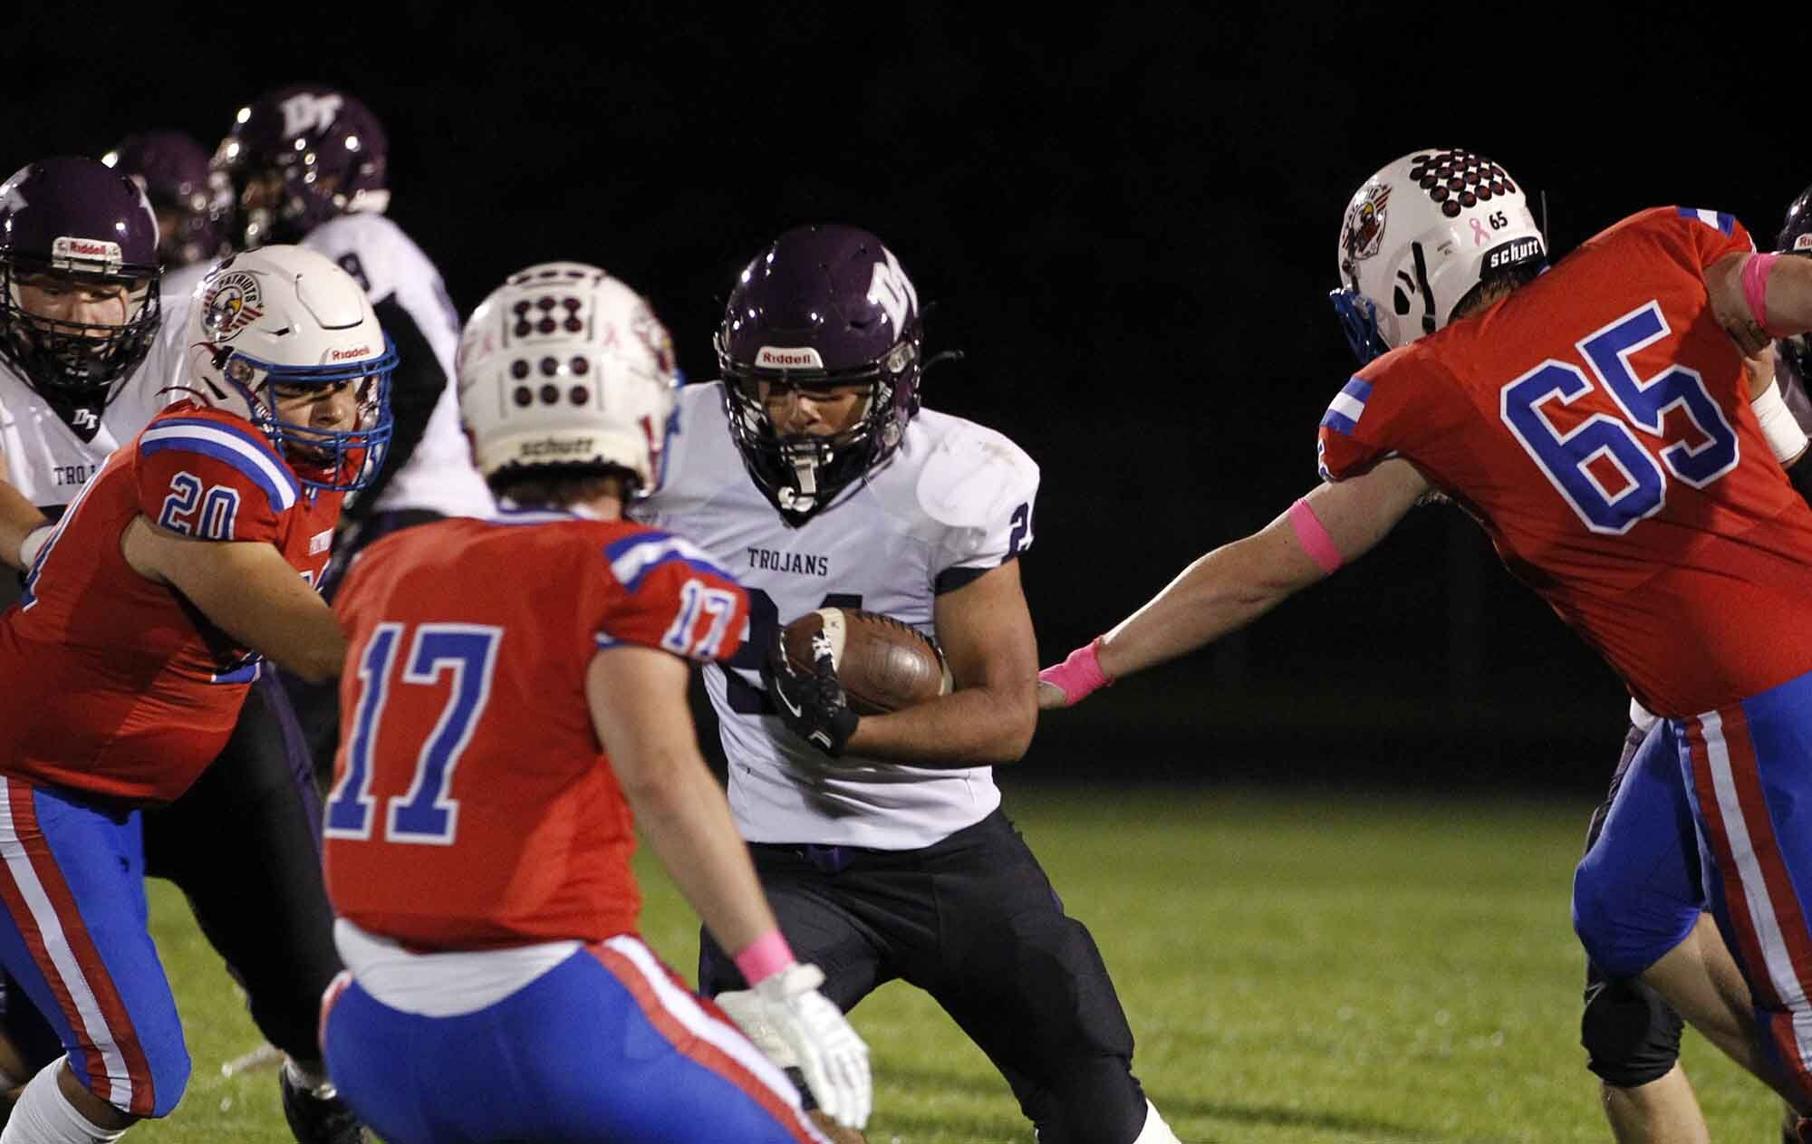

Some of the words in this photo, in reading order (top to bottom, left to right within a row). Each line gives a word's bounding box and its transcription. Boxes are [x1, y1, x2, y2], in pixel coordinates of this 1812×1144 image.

[1489, 211, 1508, 230] 65
[1490, 239, 1539, 268] schutt
[218, 273, 258, 303] PATRIOTS
[332, 346, 370, 361] Riddell
[763, 352, 811, 364] Riddell
[72, 408, 98, 430] DT
[1500, 300, 1739, 535] 65
[157, 471, 240, 540] 20
[747, 547, 829, 577] TROJANS
[660, 579, 736, 663] 17
[323, 622, 503, 845] 17
